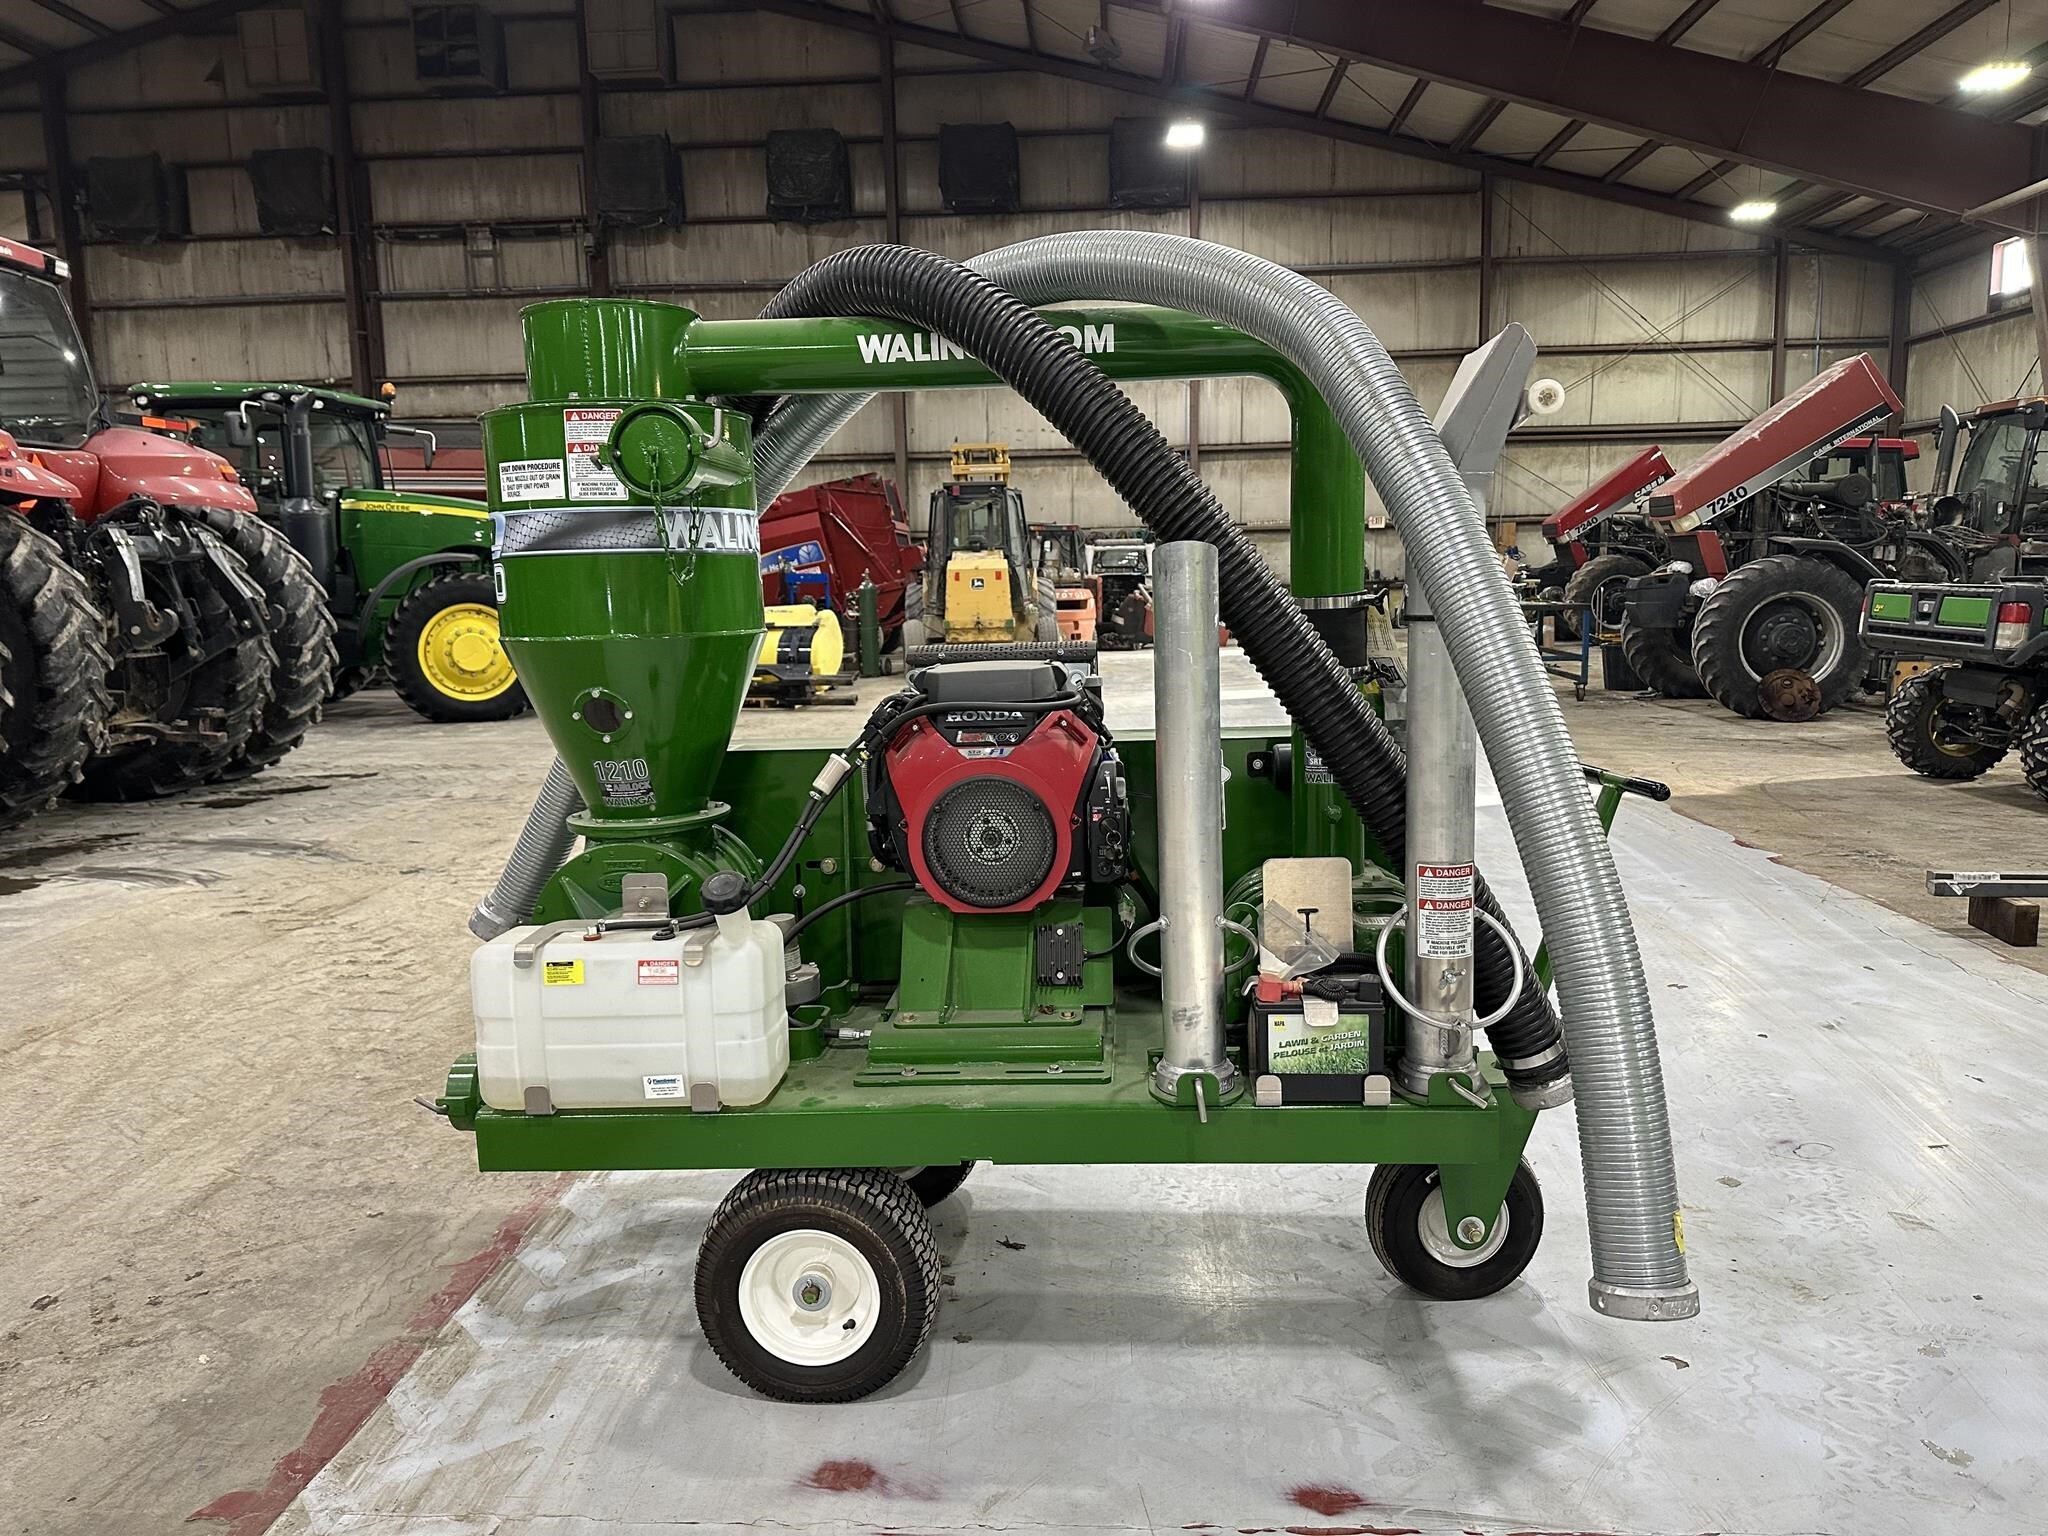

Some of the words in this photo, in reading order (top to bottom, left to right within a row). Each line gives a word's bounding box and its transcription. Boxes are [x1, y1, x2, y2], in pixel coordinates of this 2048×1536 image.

[857, 323, 1115, 364] WALINOM
[582, 412, 618, 420] DANGER
[1813, 443, 1832, 457] CASE
[1833, 415, 1881, 446] INTERNATIONAL
[501, 465, 511, 473] SHUT
[511, 464, 526, 472] DOWN
[526, 462, 561, 471] PROCEDURE
[1706, 485, 1748, 515] 7240
[365, 503, 385, 511] JOHN
[386, 503, 411, 511] DEERE
[664, 511, 759, 550] WALIN
[1575, 516, 1599, 534] 7240
[946, 710, 1025, 722] HONDA
[593, 758, 649, 781] 1210
[1306, 772, 1334, 784] WALI
[613, 782, 652, 791] AIRLOCK
[606, 795, 656, 807] WALINGA
[1436, 867, 1471, 877] DANGER
[1436, 900, 1470, 910] DANGER
[1279, 1038, 1309, 1048] LAWN
[1321, 1030, 1362, 1042] GARDEN
[1273, 1047, 1317, 1059] PELOUSE
[1329, 1040, 1366, 1052] JARDIN
